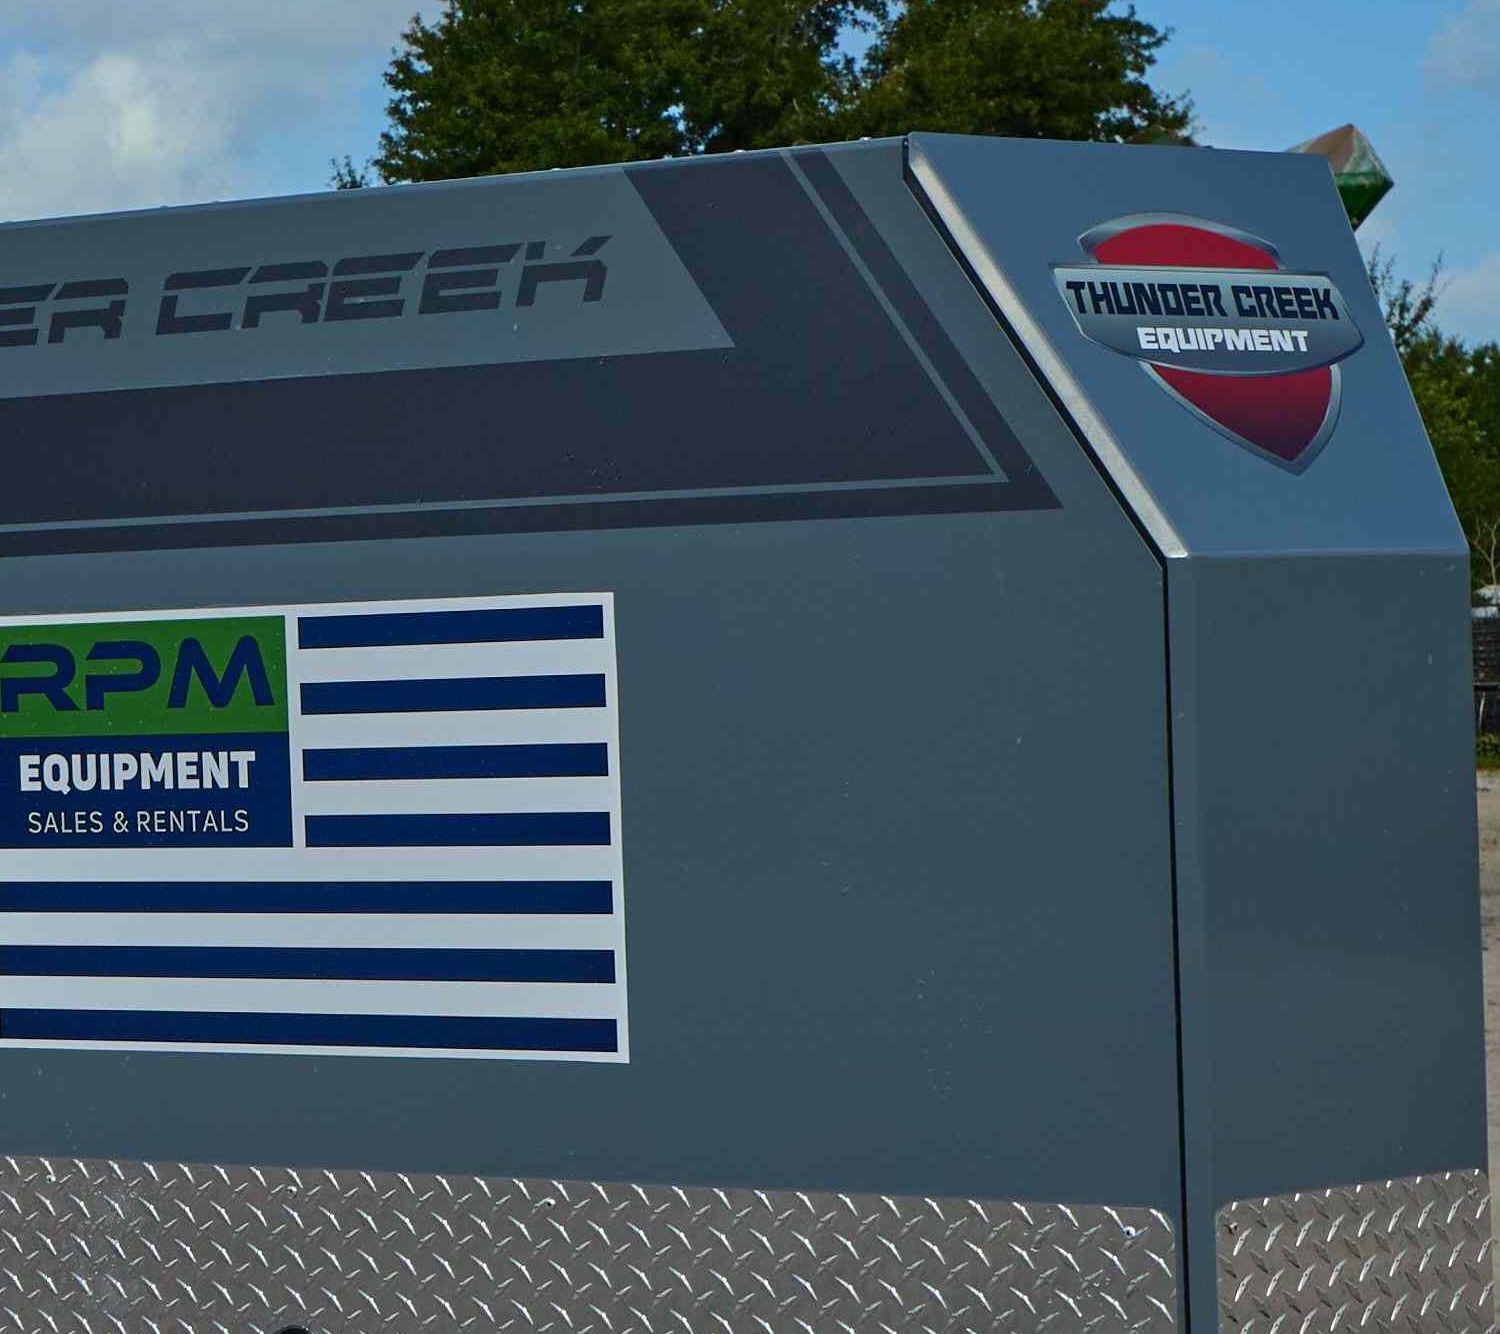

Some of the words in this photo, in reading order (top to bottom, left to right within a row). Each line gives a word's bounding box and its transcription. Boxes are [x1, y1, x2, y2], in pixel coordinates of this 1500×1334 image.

[155, 234, 614, 335] CREEK
[1066, 281, 1228, 317] THUNDER
[1231, 284, 1340, 320] CREEK
[1136, 327, 1308, 353] EQUIPMENT
[0, 634, 275, 713] RPM
[19, 750, 256, 795] EQUIPMENT
[28, 810, 104, 834] SALES
[112, 810, 130, 834] &
[137, 809, 249, 834] RENTALS
